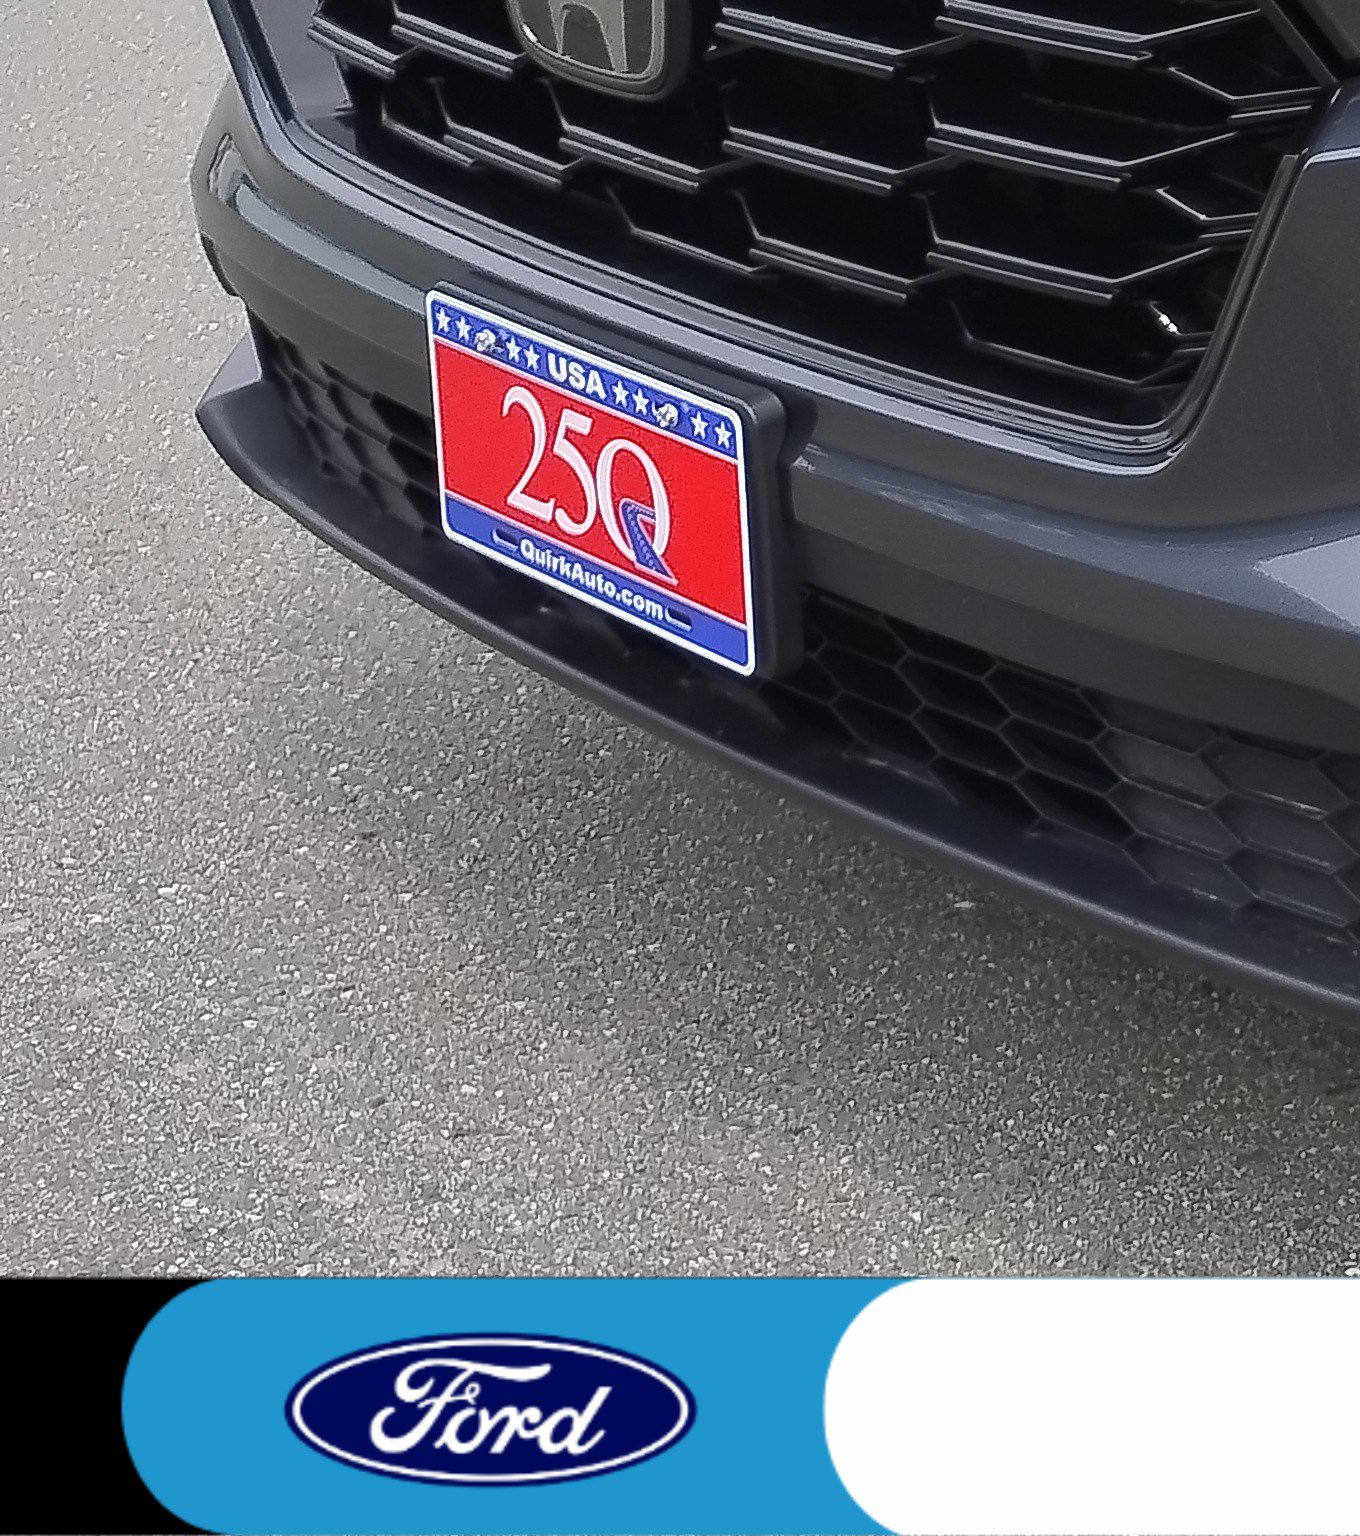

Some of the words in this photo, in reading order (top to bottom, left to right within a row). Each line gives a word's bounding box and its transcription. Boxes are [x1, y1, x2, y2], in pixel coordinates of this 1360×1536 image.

[546, 350, 608, 401] USA
[502, 384, 681, 586] 25Q
[519, 536, 664, 622] QuirkAuto.com
